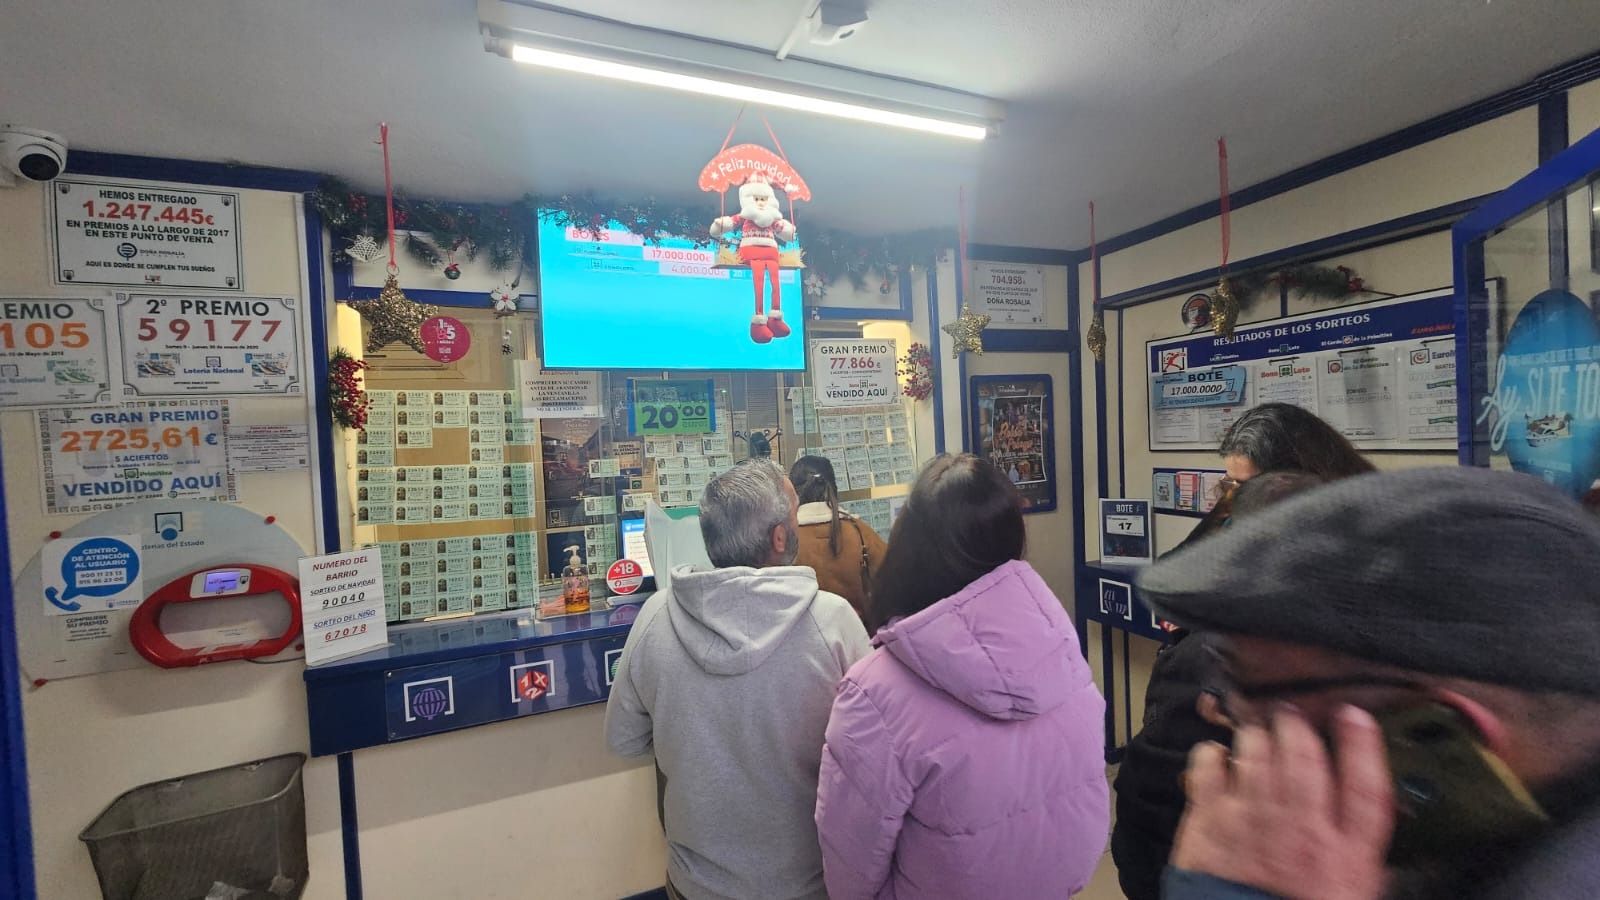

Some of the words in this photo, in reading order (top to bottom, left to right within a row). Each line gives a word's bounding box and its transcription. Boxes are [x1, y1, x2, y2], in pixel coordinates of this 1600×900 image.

[718, 157, 746, 177] Feliz
[746, 159, 792, 185] navidad
[99, 190, 135, 200] HEMOS
[137, 193, 197, 205] ENTREGADO
[82, 200, 215, 226] 1.247.445€
[66, 219, 81, 228] EN
[83, 220, 129, 231] PREMIOS
[141, 224, 155, 233] LO
[157, 225, 190, 235] LARGO
[192, 228, 206, 236] DE
[207, 228, 229, 237] 2017
[85, 229, 99, 237] EN
[102, 230, 128, 239] ESTE
[130, 232, 165, 242] PUNTO
[166, 234, 180, 242] DE
[182, 234, 214, 244] VENTA
[113, 261, 135, 269] DONDE
[146, 263, 176, 271] CUMPLEN
[180, 299, 270, 317] PREMIO
[137, 317, 282, 343] 59177
[1274, 325, 1289, 336] DE
[1291, 323, 1312, 335] LOS
[1315, 313, 1371, 331] SORTEOS
[820, 345, 849, 355] GRAN
[852, 345, 887, 354] PREMIO
[829, 356, 875, 370] 77.866
[212, 367, 245, 375] Nacional
[1187, 370, 1224, 383] BOTE
[826, 389, 864, 399] VENDIDO
[867, 386, 888, 397] AQUÍ
[90, 411, 143, 424] GRAN
[150, 409, 219, 422] PREMIO
[59, 425, 201, 453] 2725,61
[204, 432, 219, 446] €
[114, 455, 121, 463] 5
[123, 453, 169, 462] ACIERTOS
[62, 478, 164, 498] VENDIDO
[170, 471, 221, 490] AQUÍ
[1115, 504, 1133, 513] BOTE
[1118, 522, 1132, 531] 17
[82, 546, 119, 555] CENTRO
[166, 541, 179, 549] del
[179, 539, 205, 548] Estado
[84, 552, 130, 562] ATENCIÓN
[88, 559, 127, 568] USUARIO
[312, 558, 352, 572] NUMERO
[353, 555, 369, 564] DEL
[325, 569, 358, 582] BARRIO
[614, 562, 635, 575] +18
[310, 585, 337, 597] SORTEO
[337, 584, 347, 592] DE
[347, 578, 376, 589] NAVIDAD
[321, 591, 365, 610] 90040
[313, 617, 342, 630] SORTEO
[343, 614, 357, 624] DEL
[357, 609, 376, 621] NIÑO
[324, 623, 367, 642] 67078
